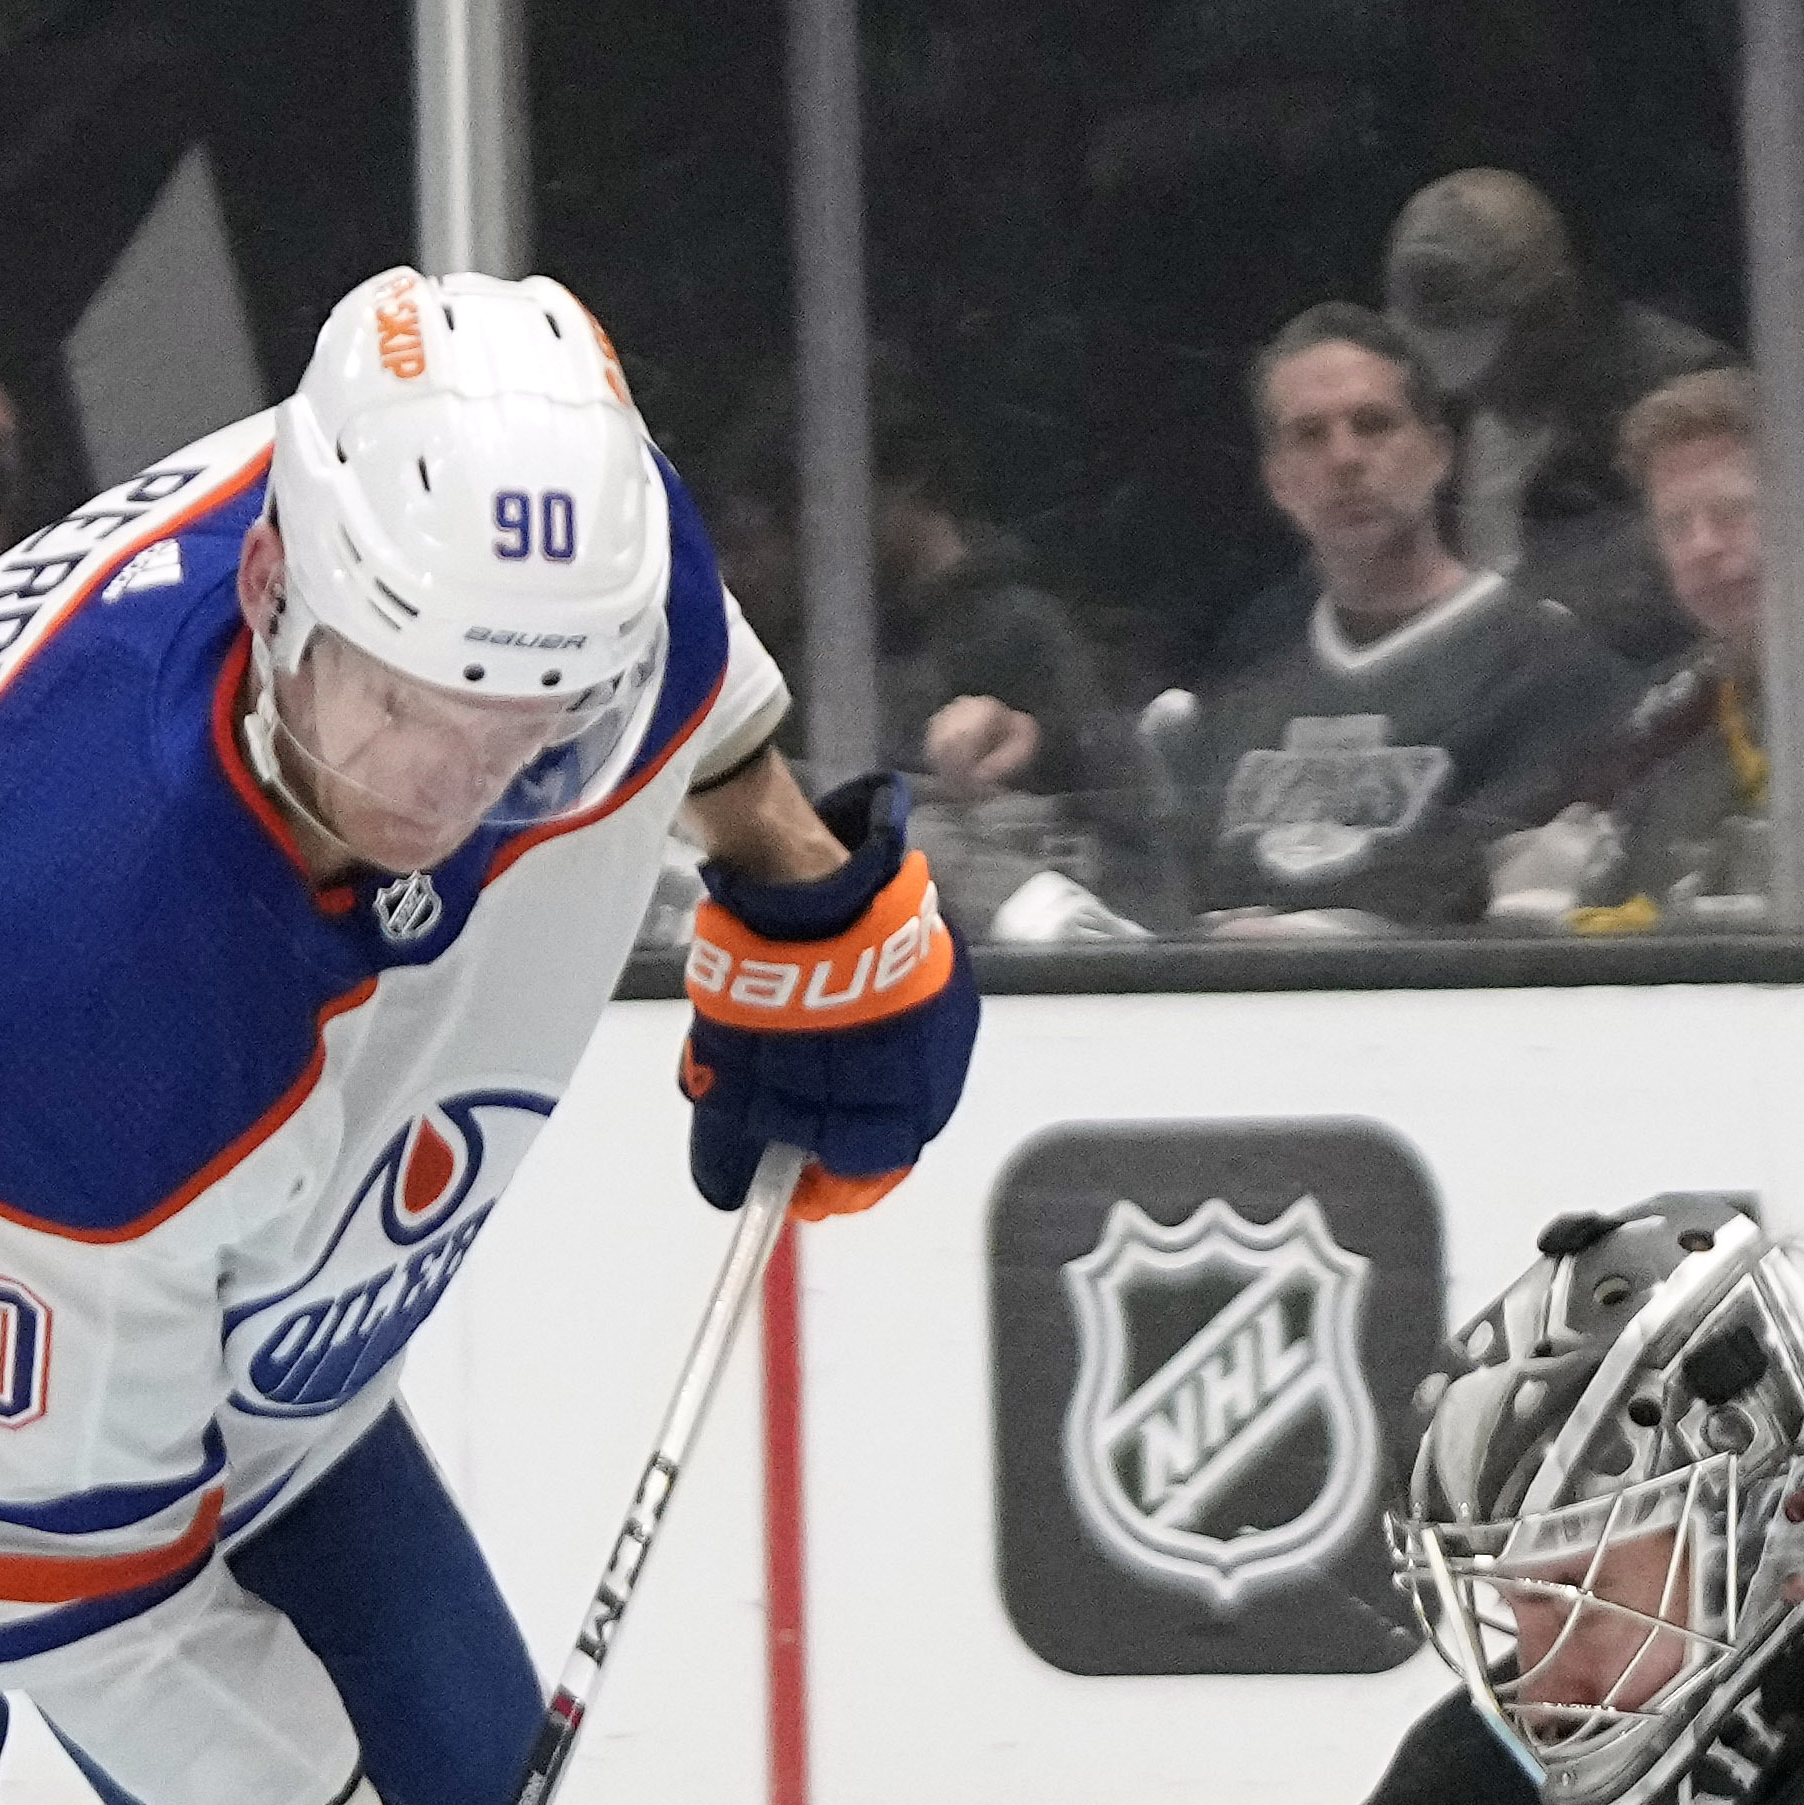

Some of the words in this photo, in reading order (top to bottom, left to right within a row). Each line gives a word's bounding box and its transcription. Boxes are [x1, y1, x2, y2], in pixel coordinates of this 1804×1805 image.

[492, 486, 577, 564] 90
[463, 625, 588, 649] BAUER
[1139, 1296, 1312, 1503] NHL
[574, 1449, 679, 1669] CCM
